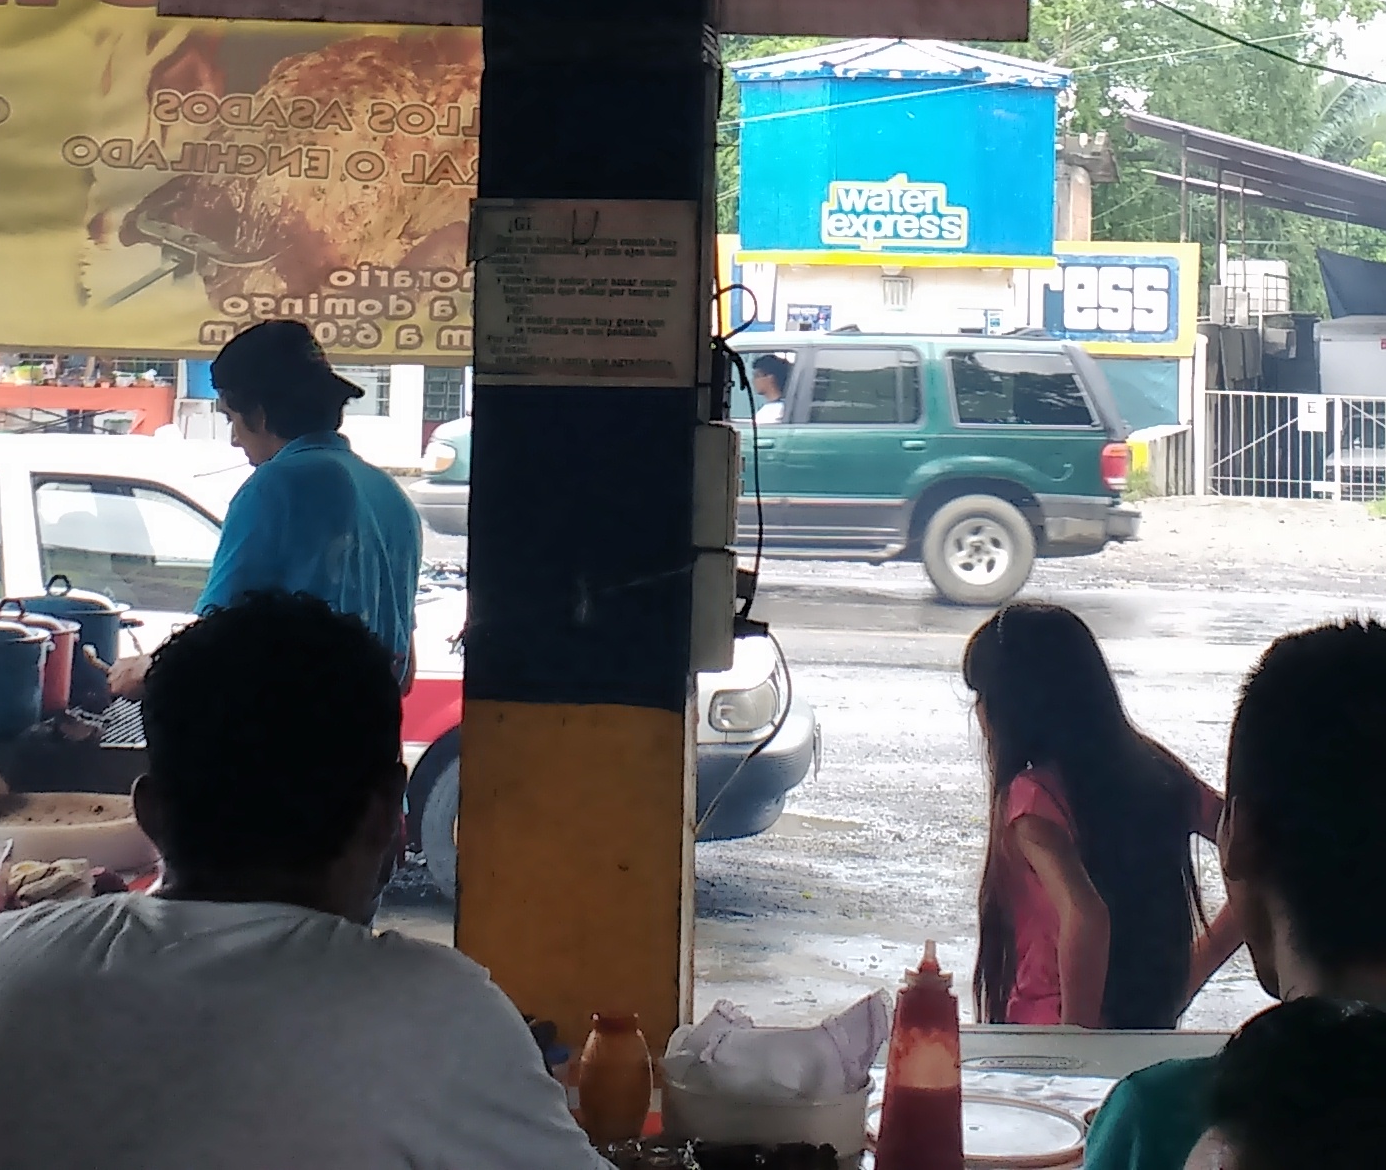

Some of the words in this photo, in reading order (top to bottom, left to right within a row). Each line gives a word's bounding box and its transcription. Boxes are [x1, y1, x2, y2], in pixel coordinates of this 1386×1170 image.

[836, 182, 940, 215] water
[827, 212, 963, 244] express
[1025, 265, 1170, 333] ress
